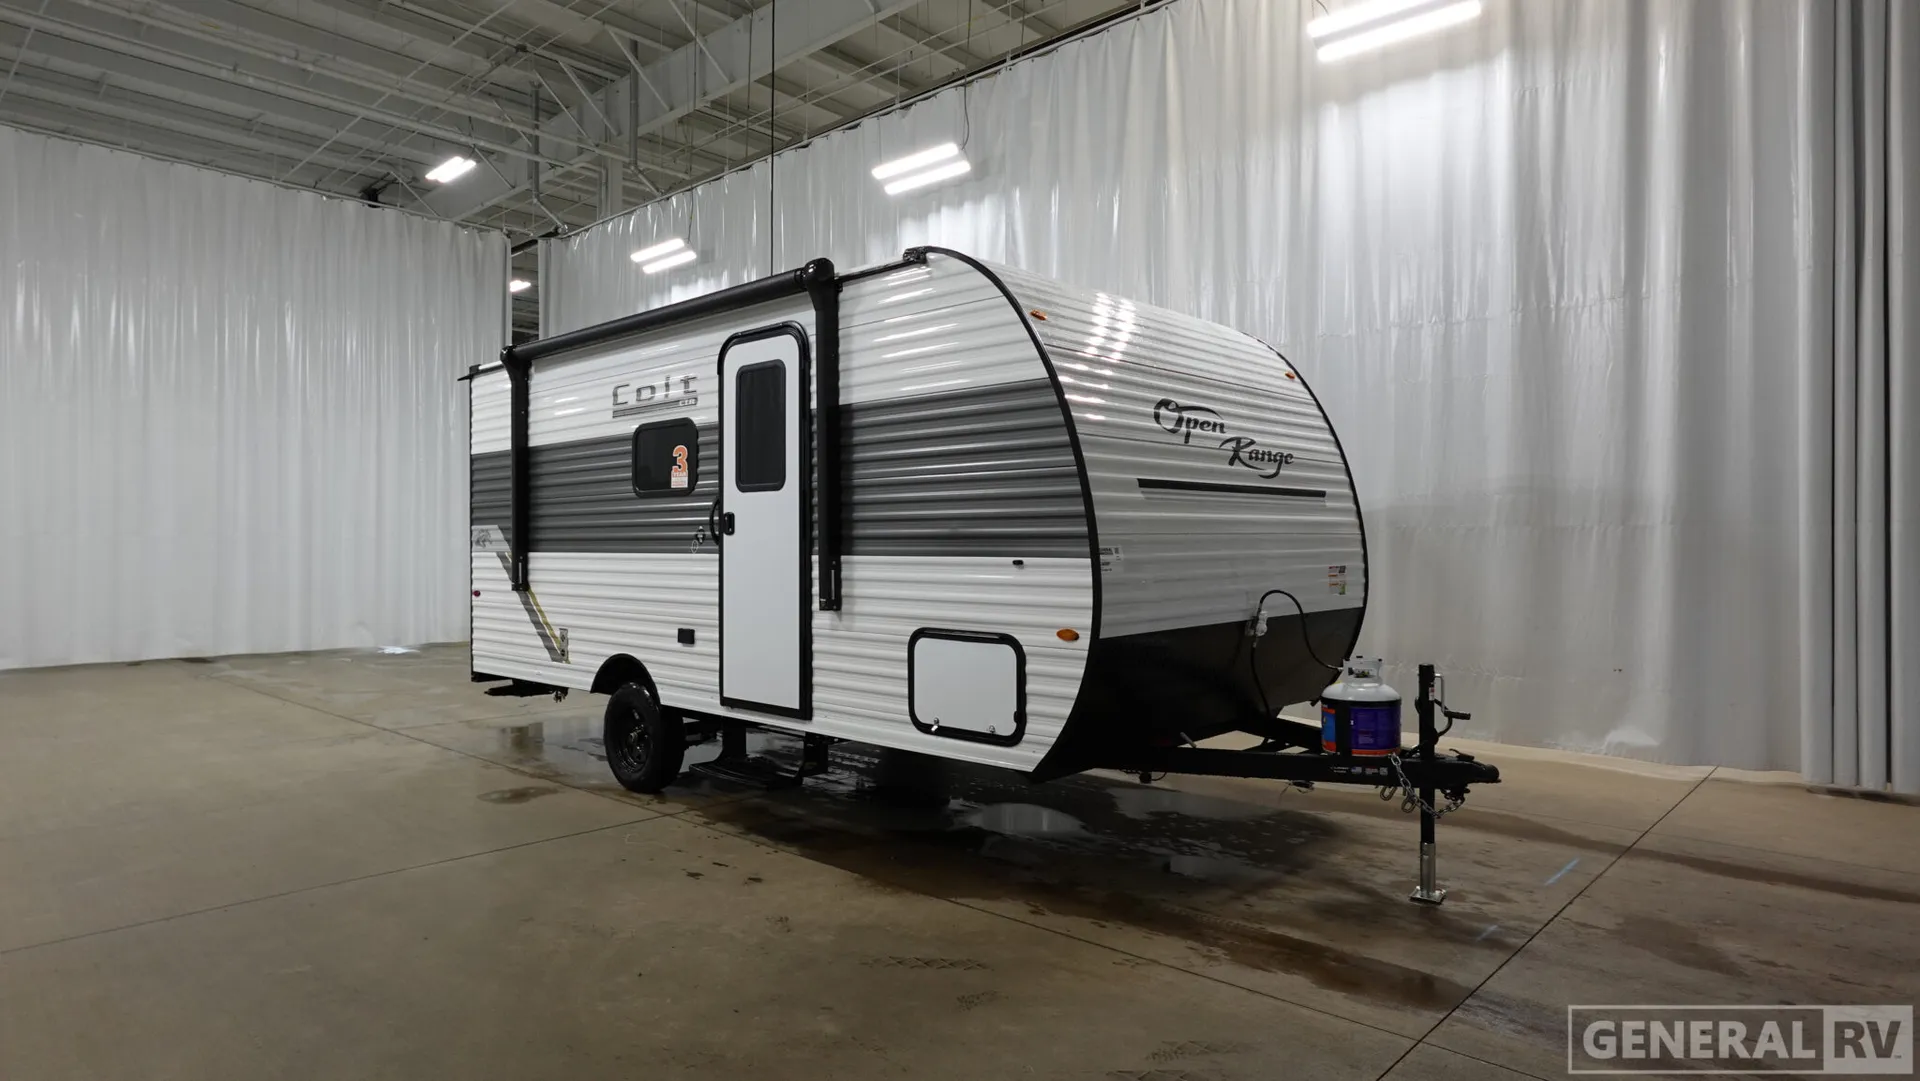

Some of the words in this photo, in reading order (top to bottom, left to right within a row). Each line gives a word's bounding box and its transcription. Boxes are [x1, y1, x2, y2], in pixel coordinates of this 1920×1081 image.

[613, 375, 697, 406] Colt
[1154, 398, 1226, 444] Open
[672, 444, 688, 473] 3
[1219, 437, 1295, 479] Range
